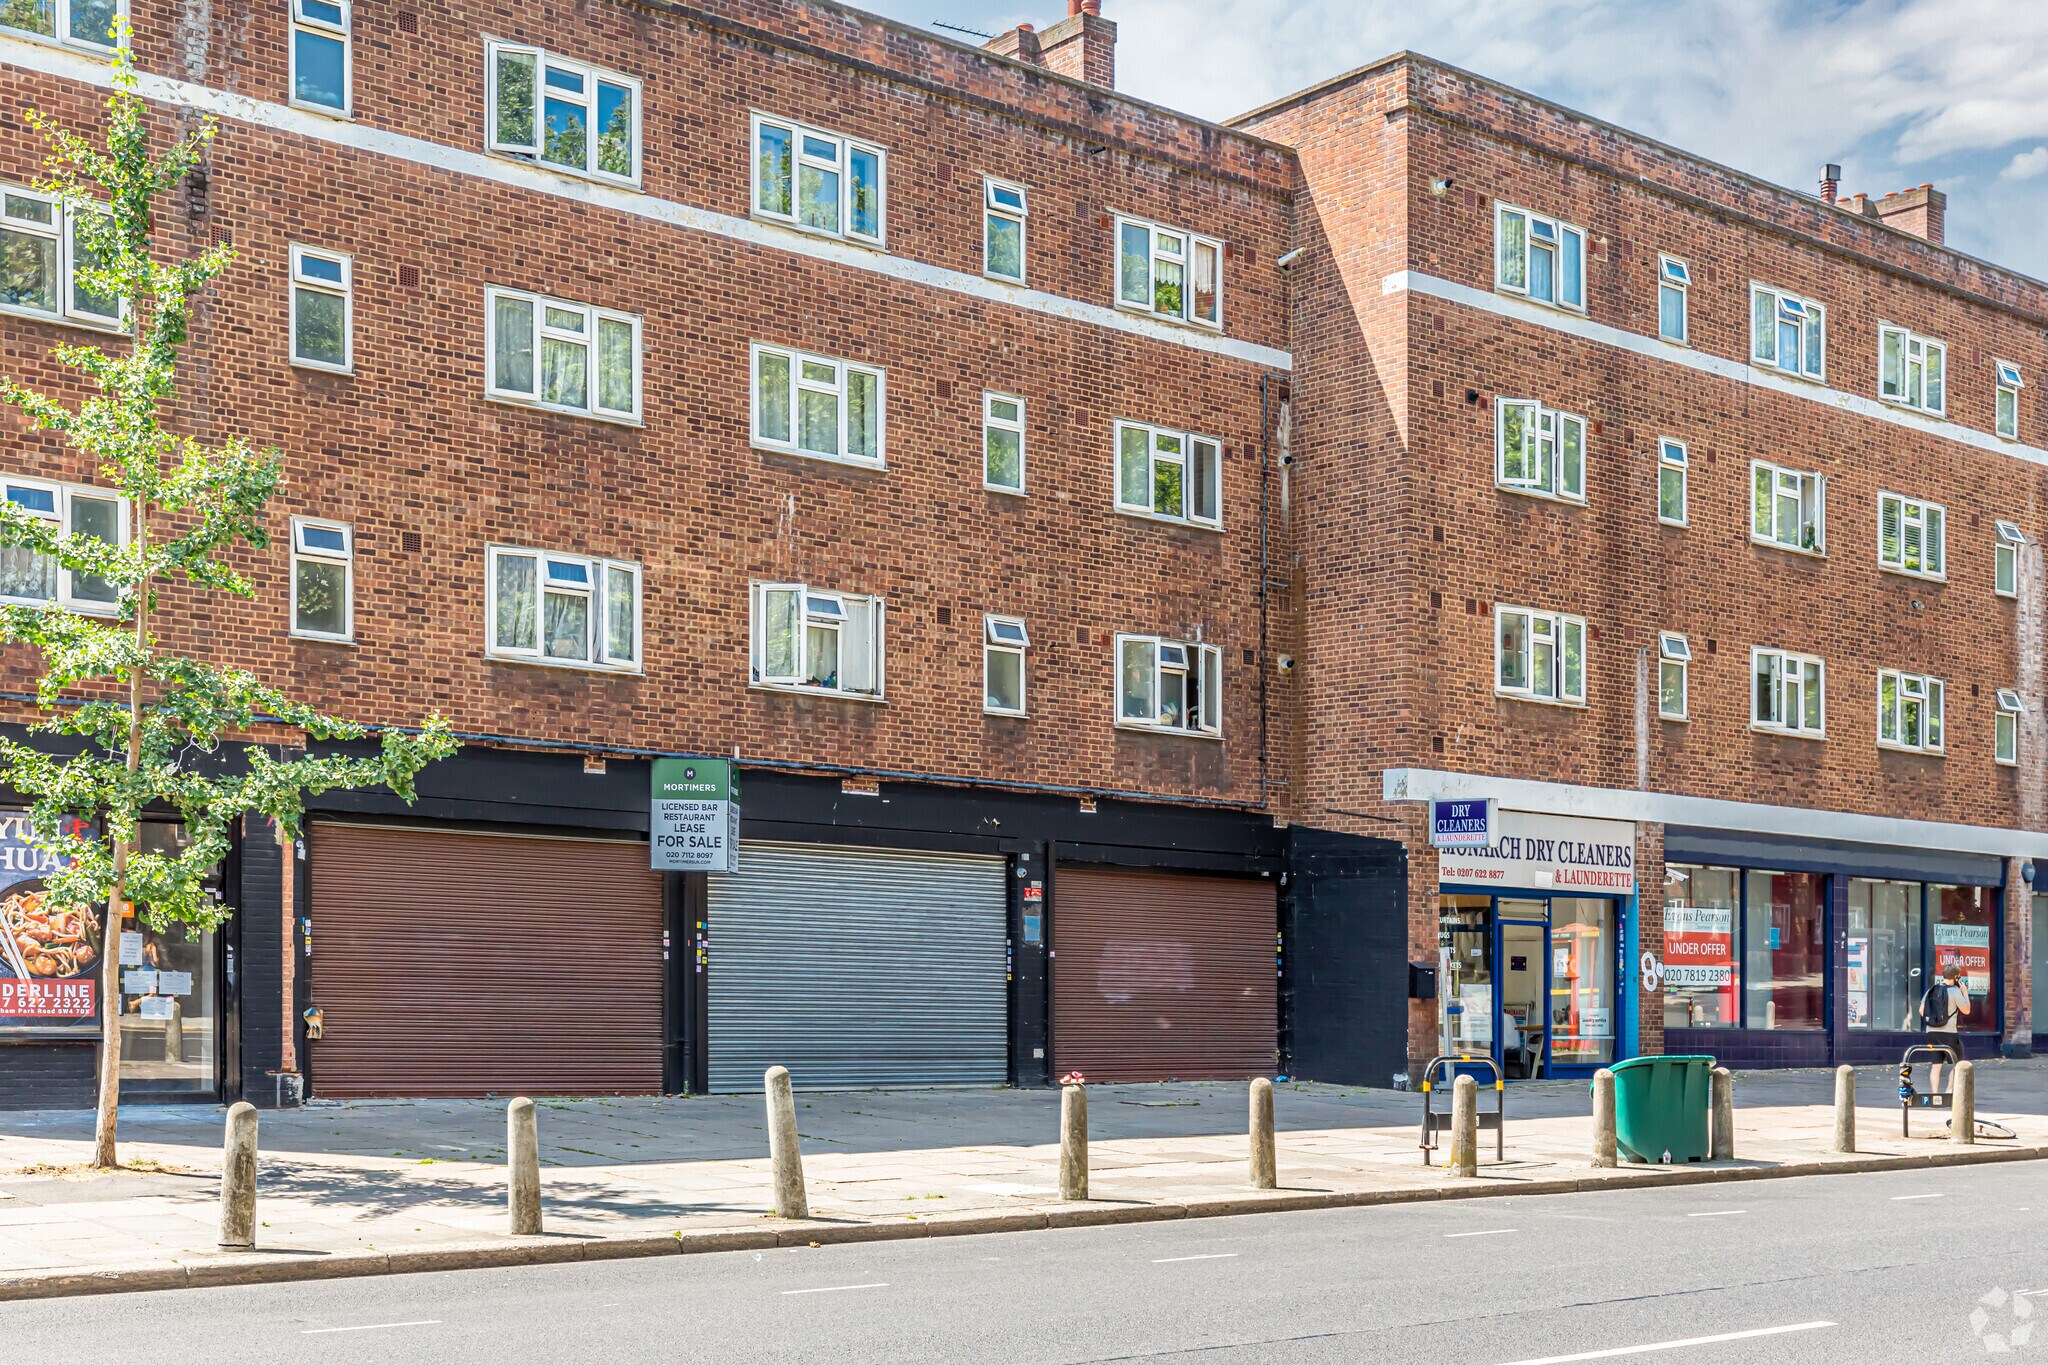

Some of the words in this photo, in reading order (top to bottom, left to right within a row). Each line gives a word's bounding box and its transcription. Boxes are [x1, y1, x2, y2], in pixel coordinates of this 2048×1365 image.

[663, 783, 717, 792] MORTIMERS
[661, 803, 699, 811] LICENSED
[701, 803, 718, 811] BAR
[1451, 804, 1471, 818] DRY
[663, 813, 716, 821] RESTAURANT
[674, 823, 706, 833] LEASE
[1437, 818, 1486, 833] CLEANERS
[657, 835, 685, 848] FOR
[689, 836, 722, 848] SALE
[1442, 833, 1486, 842] LAUNDERETTE
[1525, 838, 1555, 862] DRY
[1558, 840, 1632, 868] CLEANERS
[1441, 867, 1455, 877] Tel:
[1457, 868, 1474, 878] 0207
[1474, 869, 1488, 879] 622
[1488, 870, 1505, 880] 8877
[1555, 868, 1562, 884] &
[1564, 868, 1632, 888] LAUNDERETTE
[1665, 908, 1693, 921] Evans
[1695, 909, 1730, 923] Pearson
[1960, 925, 1989, 938] Pearson
[1668, 942, 1700, 955] UNDER
[1700, 943, 1727, 956] OFFER
[1939, 954, 1965, 967] UNDER
[1965, 955, 1986, 968] OFFER
[1664, 968, 1682, 981] 020
[1684, 969, 1707, 982] 7819
[1708, 969, 1730, 982] 2380
[2, 983, 90, 998] DERLINE
[2, 997, 11, 1008] 7
[17, 997, 46, 1008] 622
[53, 997, 91, 1009] 2322
